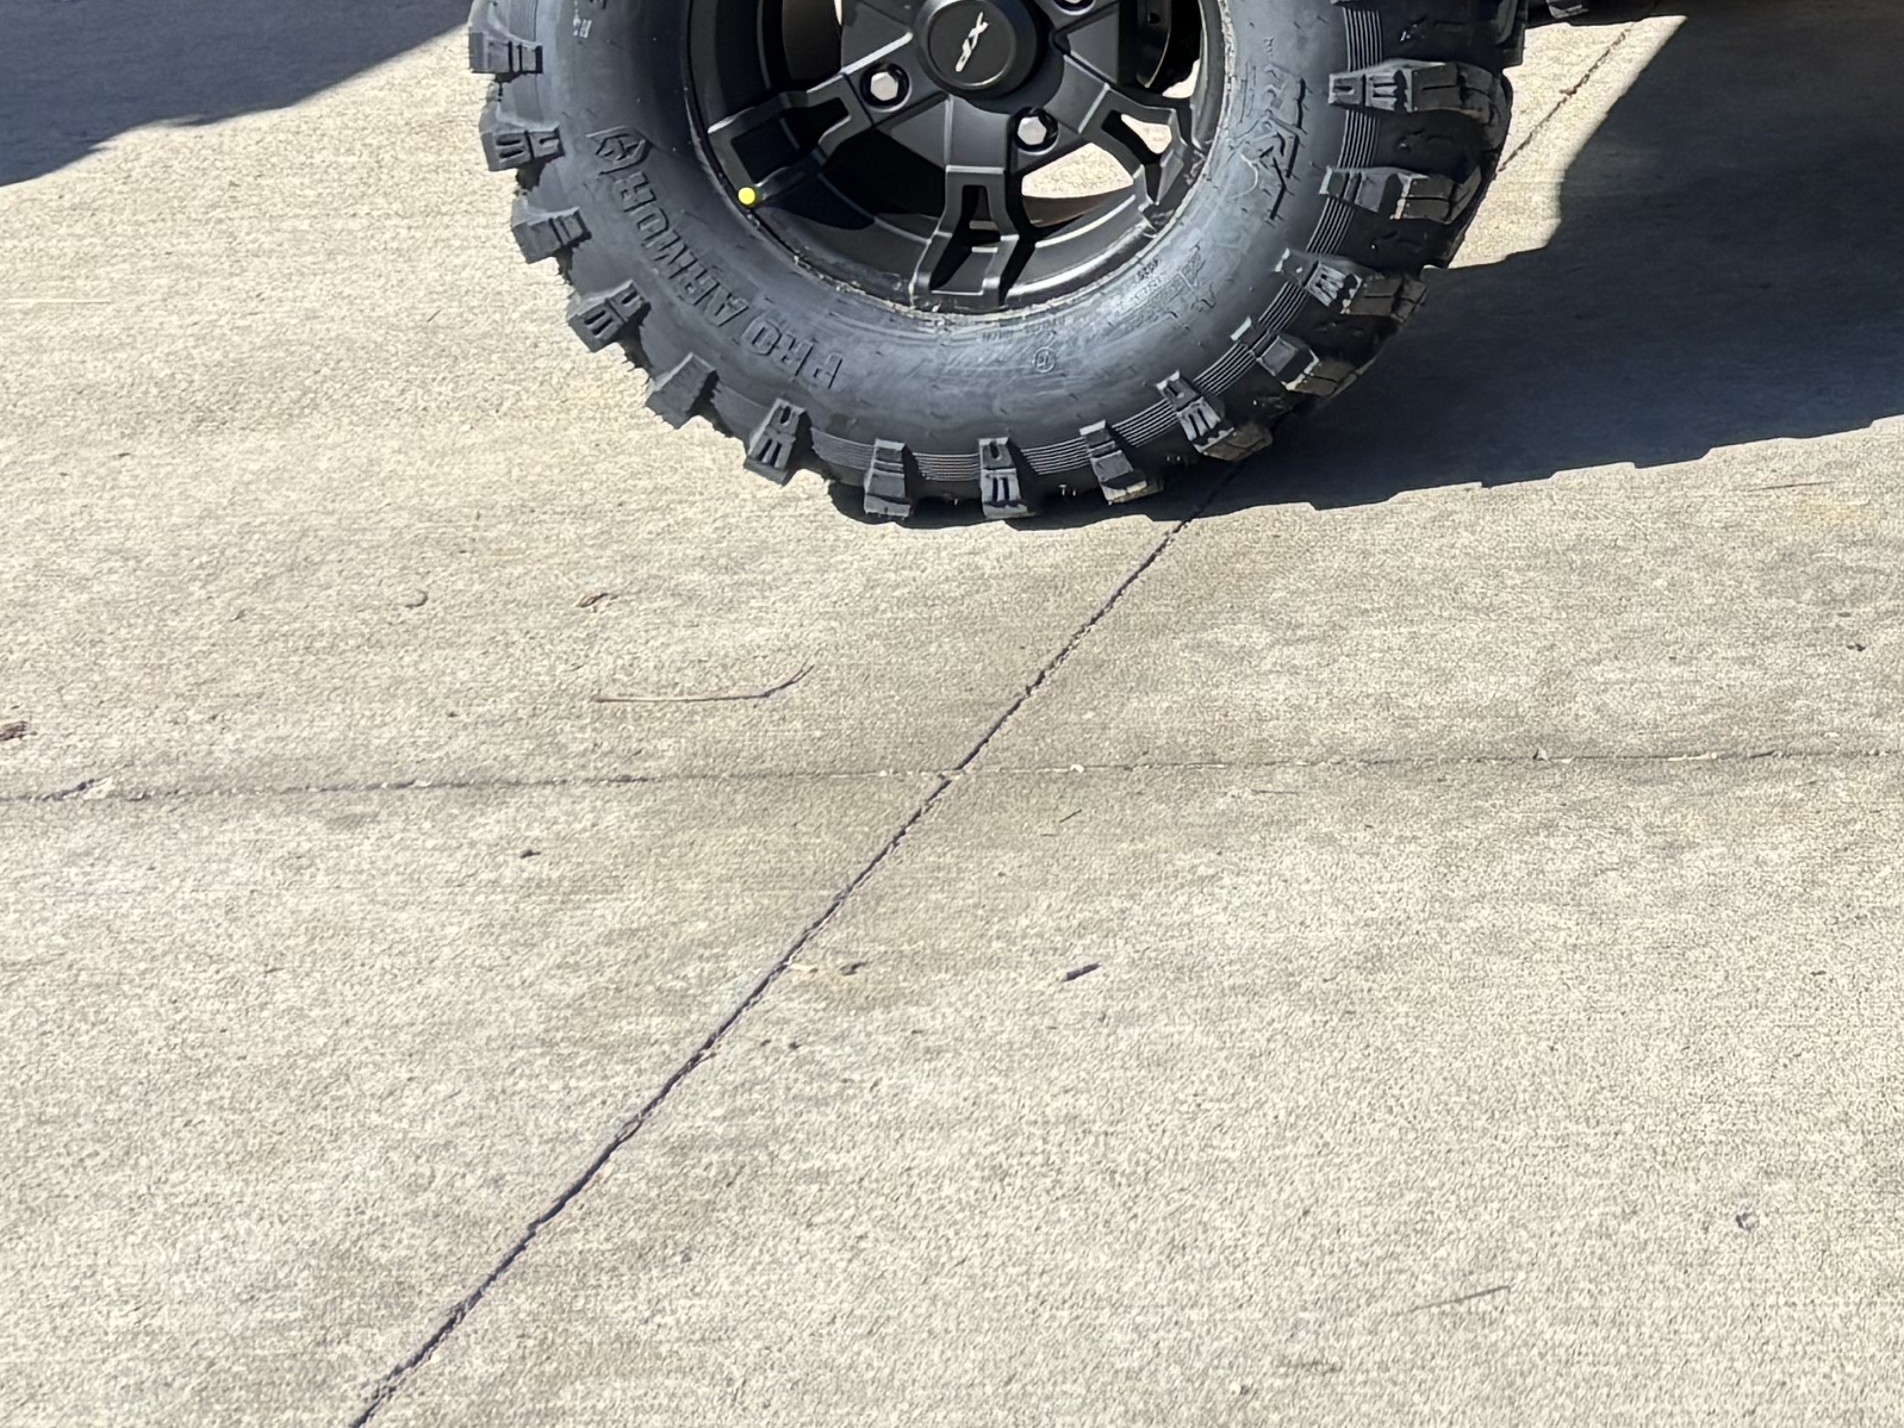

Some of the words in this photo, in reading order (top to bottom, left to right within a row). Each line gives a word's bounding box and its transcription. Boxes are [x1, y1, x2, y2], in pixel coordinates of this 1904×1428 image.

[955, 11, 988, 72] XP
[613, 170, 749, 328] ARMOR
[739, 314, 845, 390] PRO
